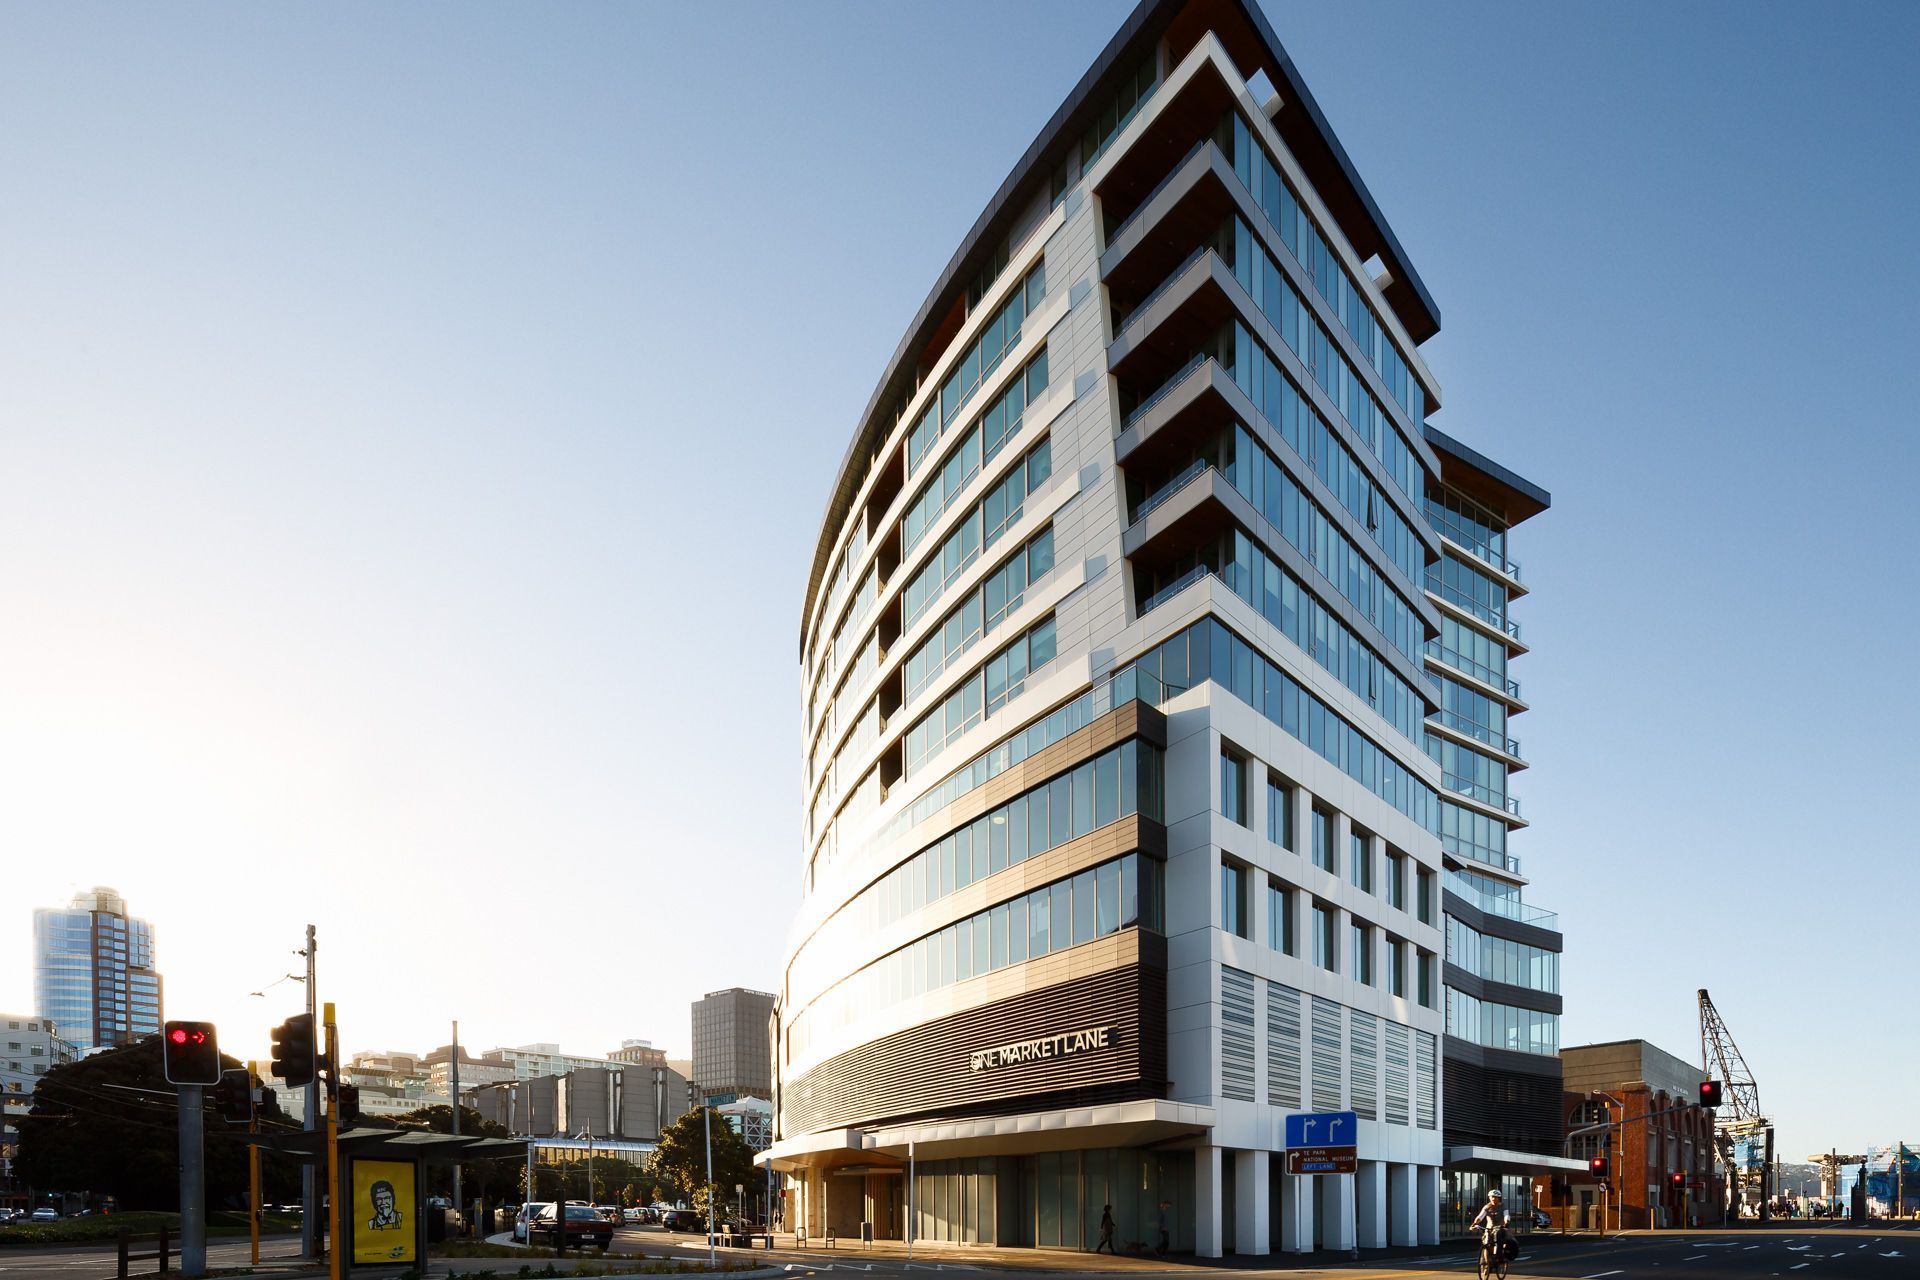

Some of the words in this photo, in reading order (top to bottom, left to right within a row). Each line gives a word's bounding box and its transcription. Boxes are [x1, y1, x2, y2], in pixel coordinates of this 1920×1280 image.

[970, 1051, 998, 1071] ONE
[999, 1037, 1061, 1065] MARKET
[1064, 1026, 1109, 1053] LANE
